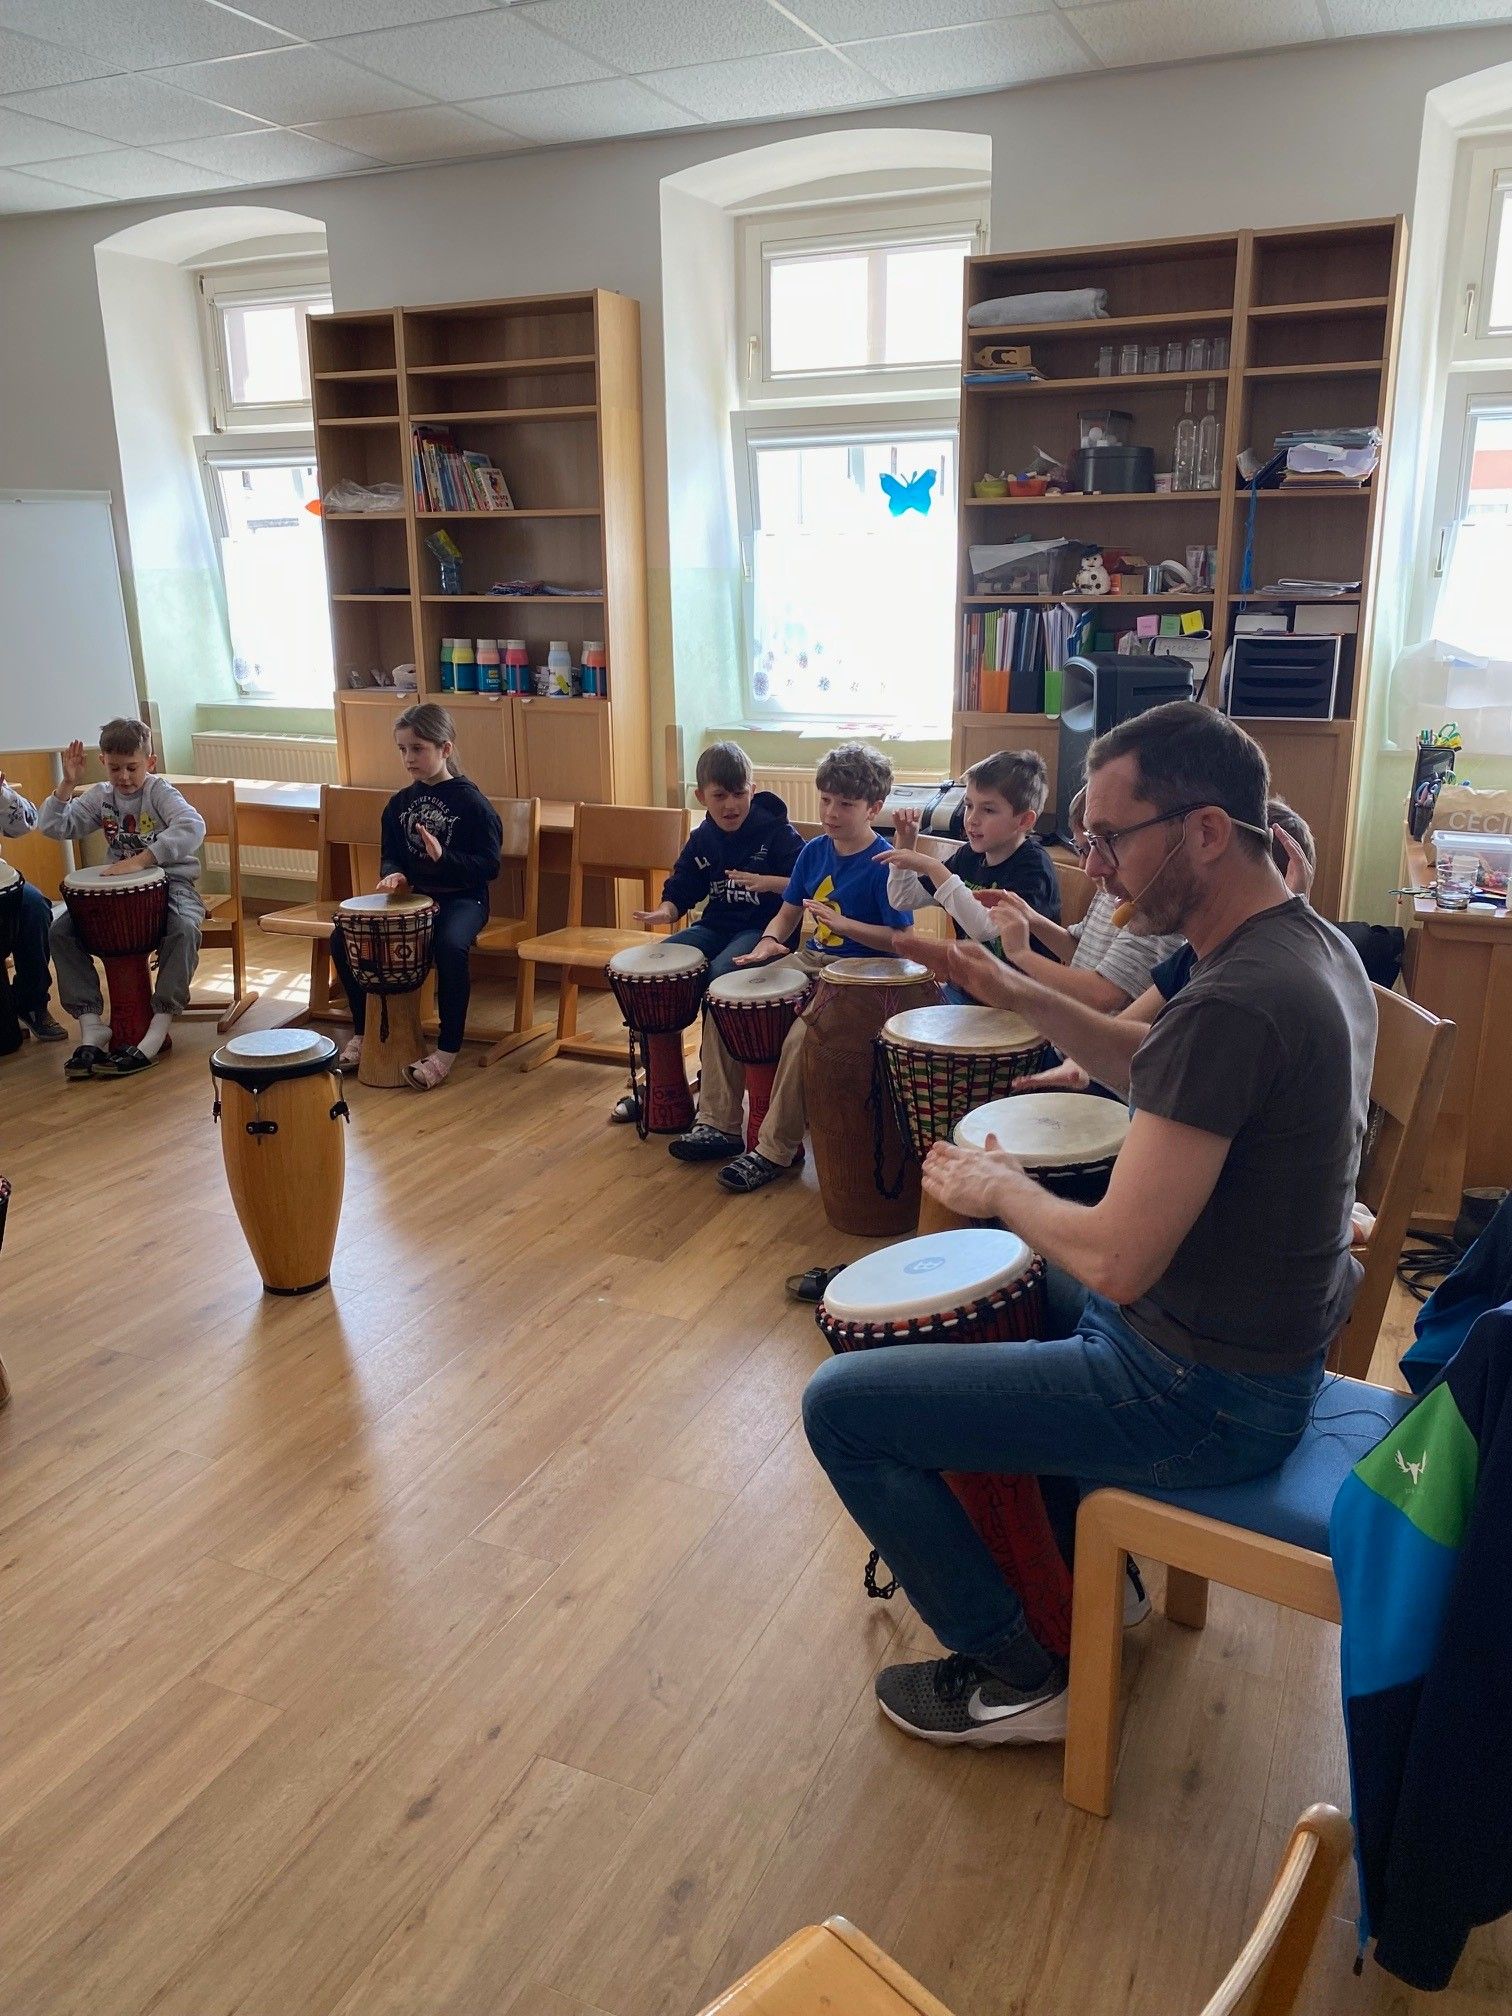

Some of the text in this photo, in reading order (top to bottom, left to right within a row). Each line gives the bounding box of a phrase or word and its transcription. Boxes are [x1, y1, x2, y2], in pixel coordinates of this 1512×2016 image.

[407, 795, 450, 814] ACTIVE GIRLS
[1448, 811, 1512, 834] CECI
